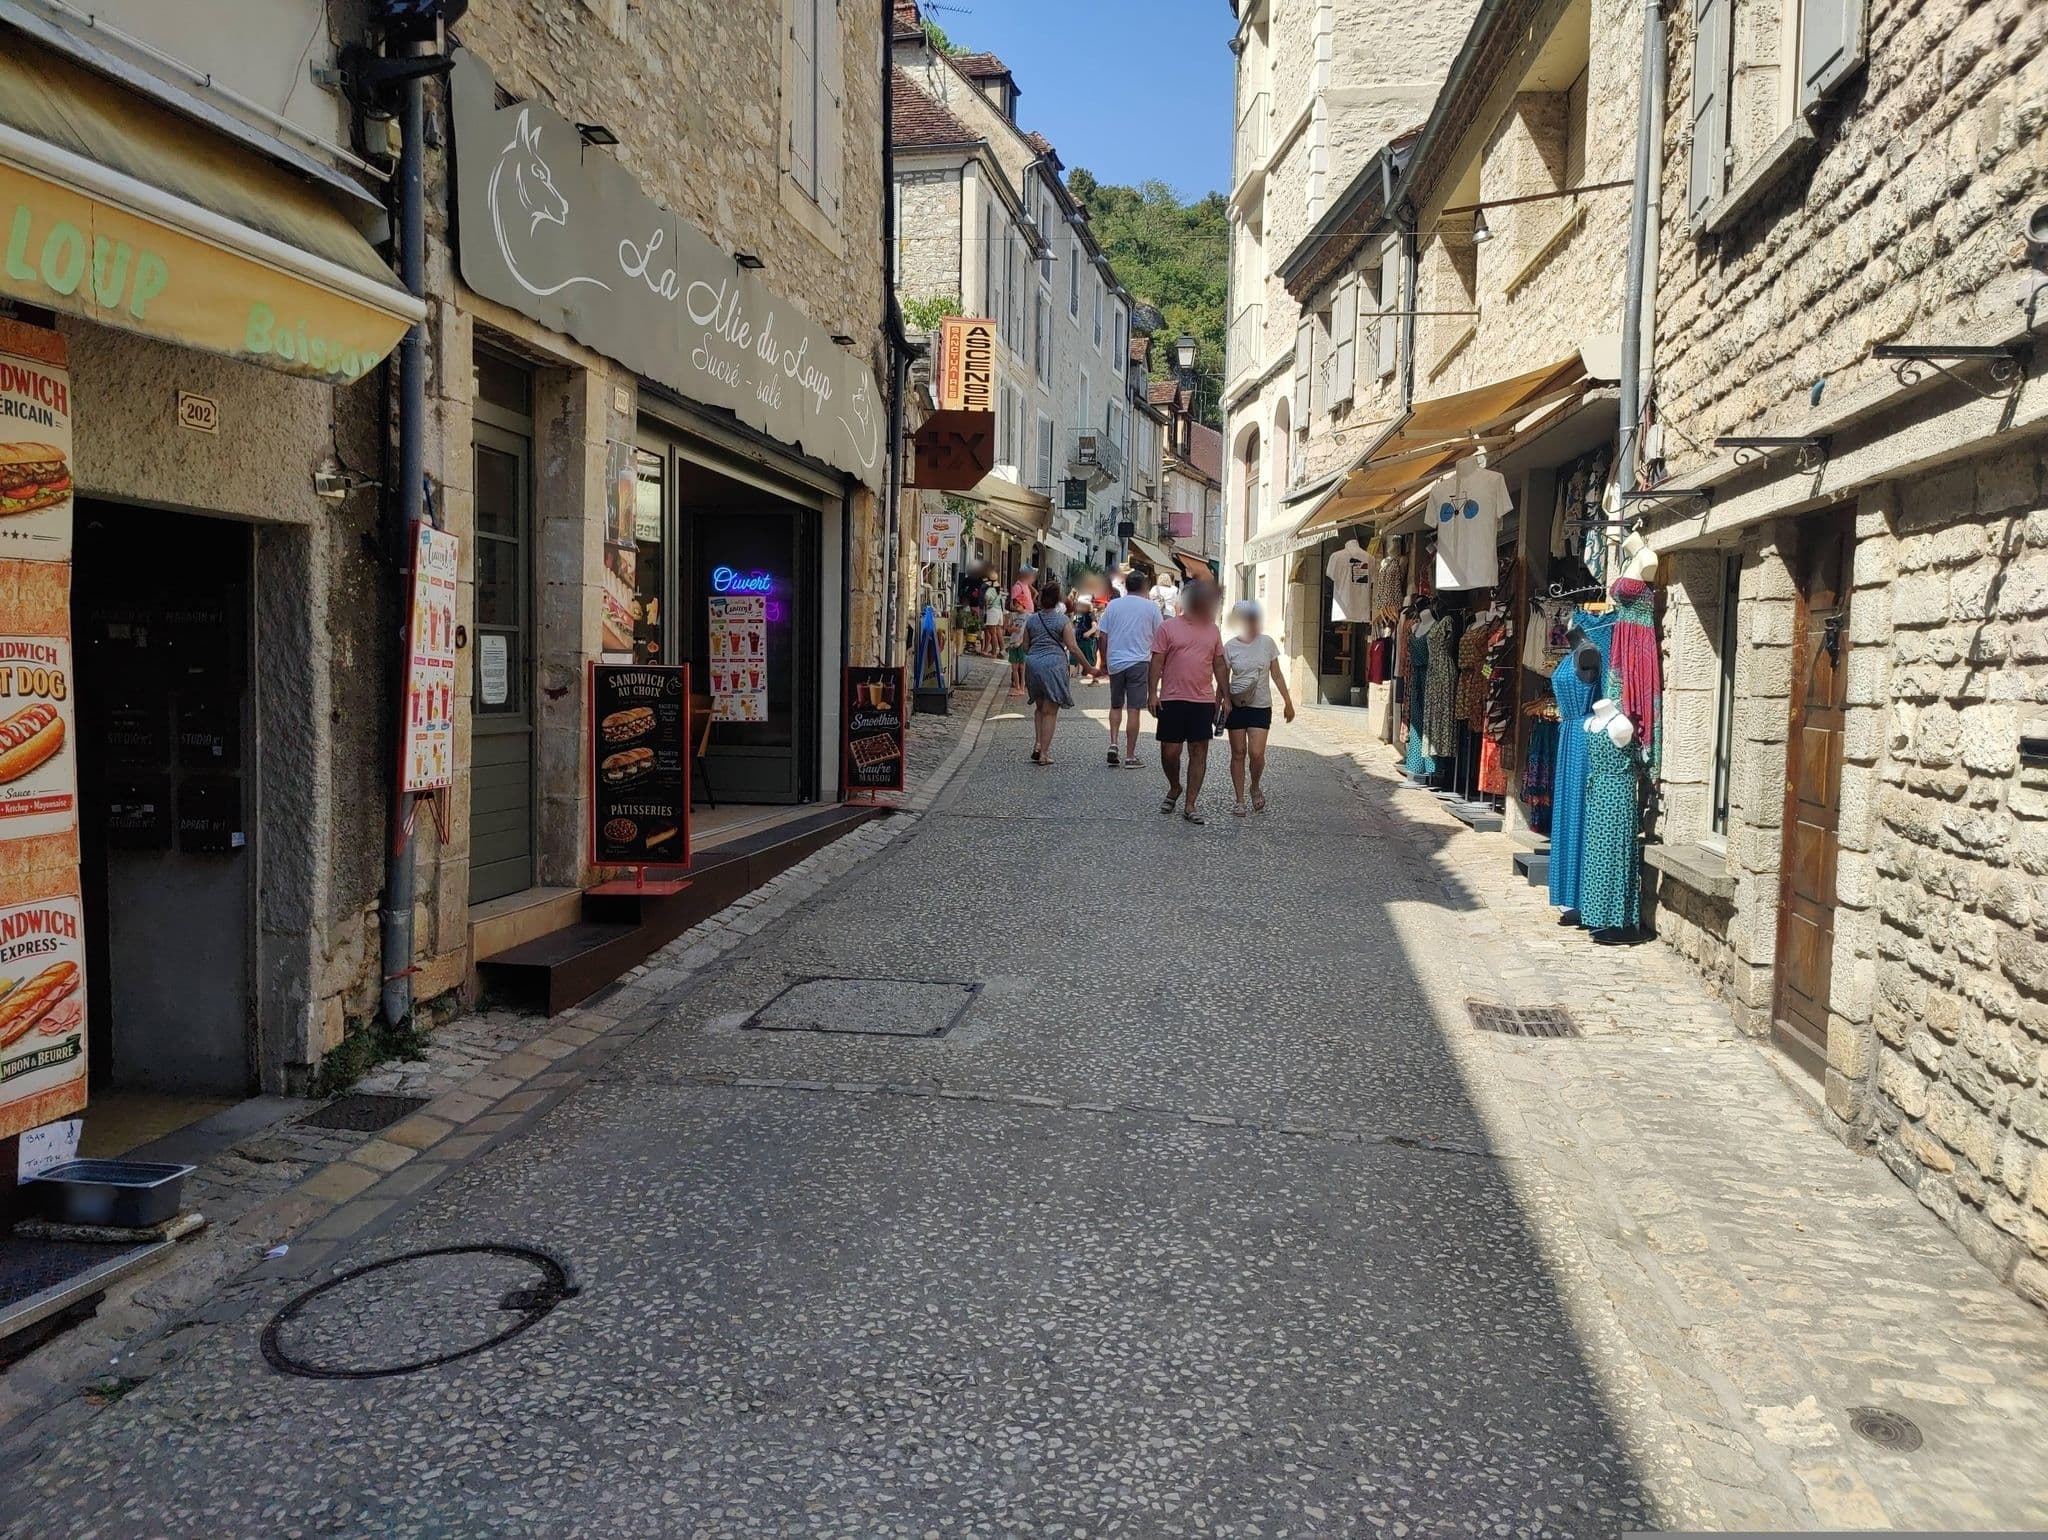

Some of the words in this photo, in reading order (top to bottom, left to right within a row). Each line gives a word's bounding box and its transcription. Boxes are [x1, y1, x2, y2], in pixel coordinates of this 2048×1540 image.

[6, 205, 169, 319] LOUP
[618, 228, 680, 300] La
[757, 312, 780, 366] du
[783, 336, 833, 415] Loup
[692, 332, 740, 388] Sucré
[756, 374, 782, 410] salé
[949, 327, 960, 398] SANCTUAIRES
[187, 403, 212, 422] 202
[714, 567, 772, 592] Ouvert
[17, 667, 66, 701] DOG
[609, 673, 665, 688] SANDWICH
[617, 686, 630, 698] AU
[632, 686, 661, 698] CHOIX
[851, 713, 899, 730] Smoothies
[858, 774, 891, 783] MAISON
[5, 788, 31, 799] Sauce
[5, 803, 29, 813] Ketchup
[33, 799, 67, 810] Mayonnaise
[0, 910, 77, 946] NDWICH
[1, 938, 57, 963] EXPRESS
[1, 1057, 30, 1078] MBON
[38, 1044, 74, 1065] BEURRE
